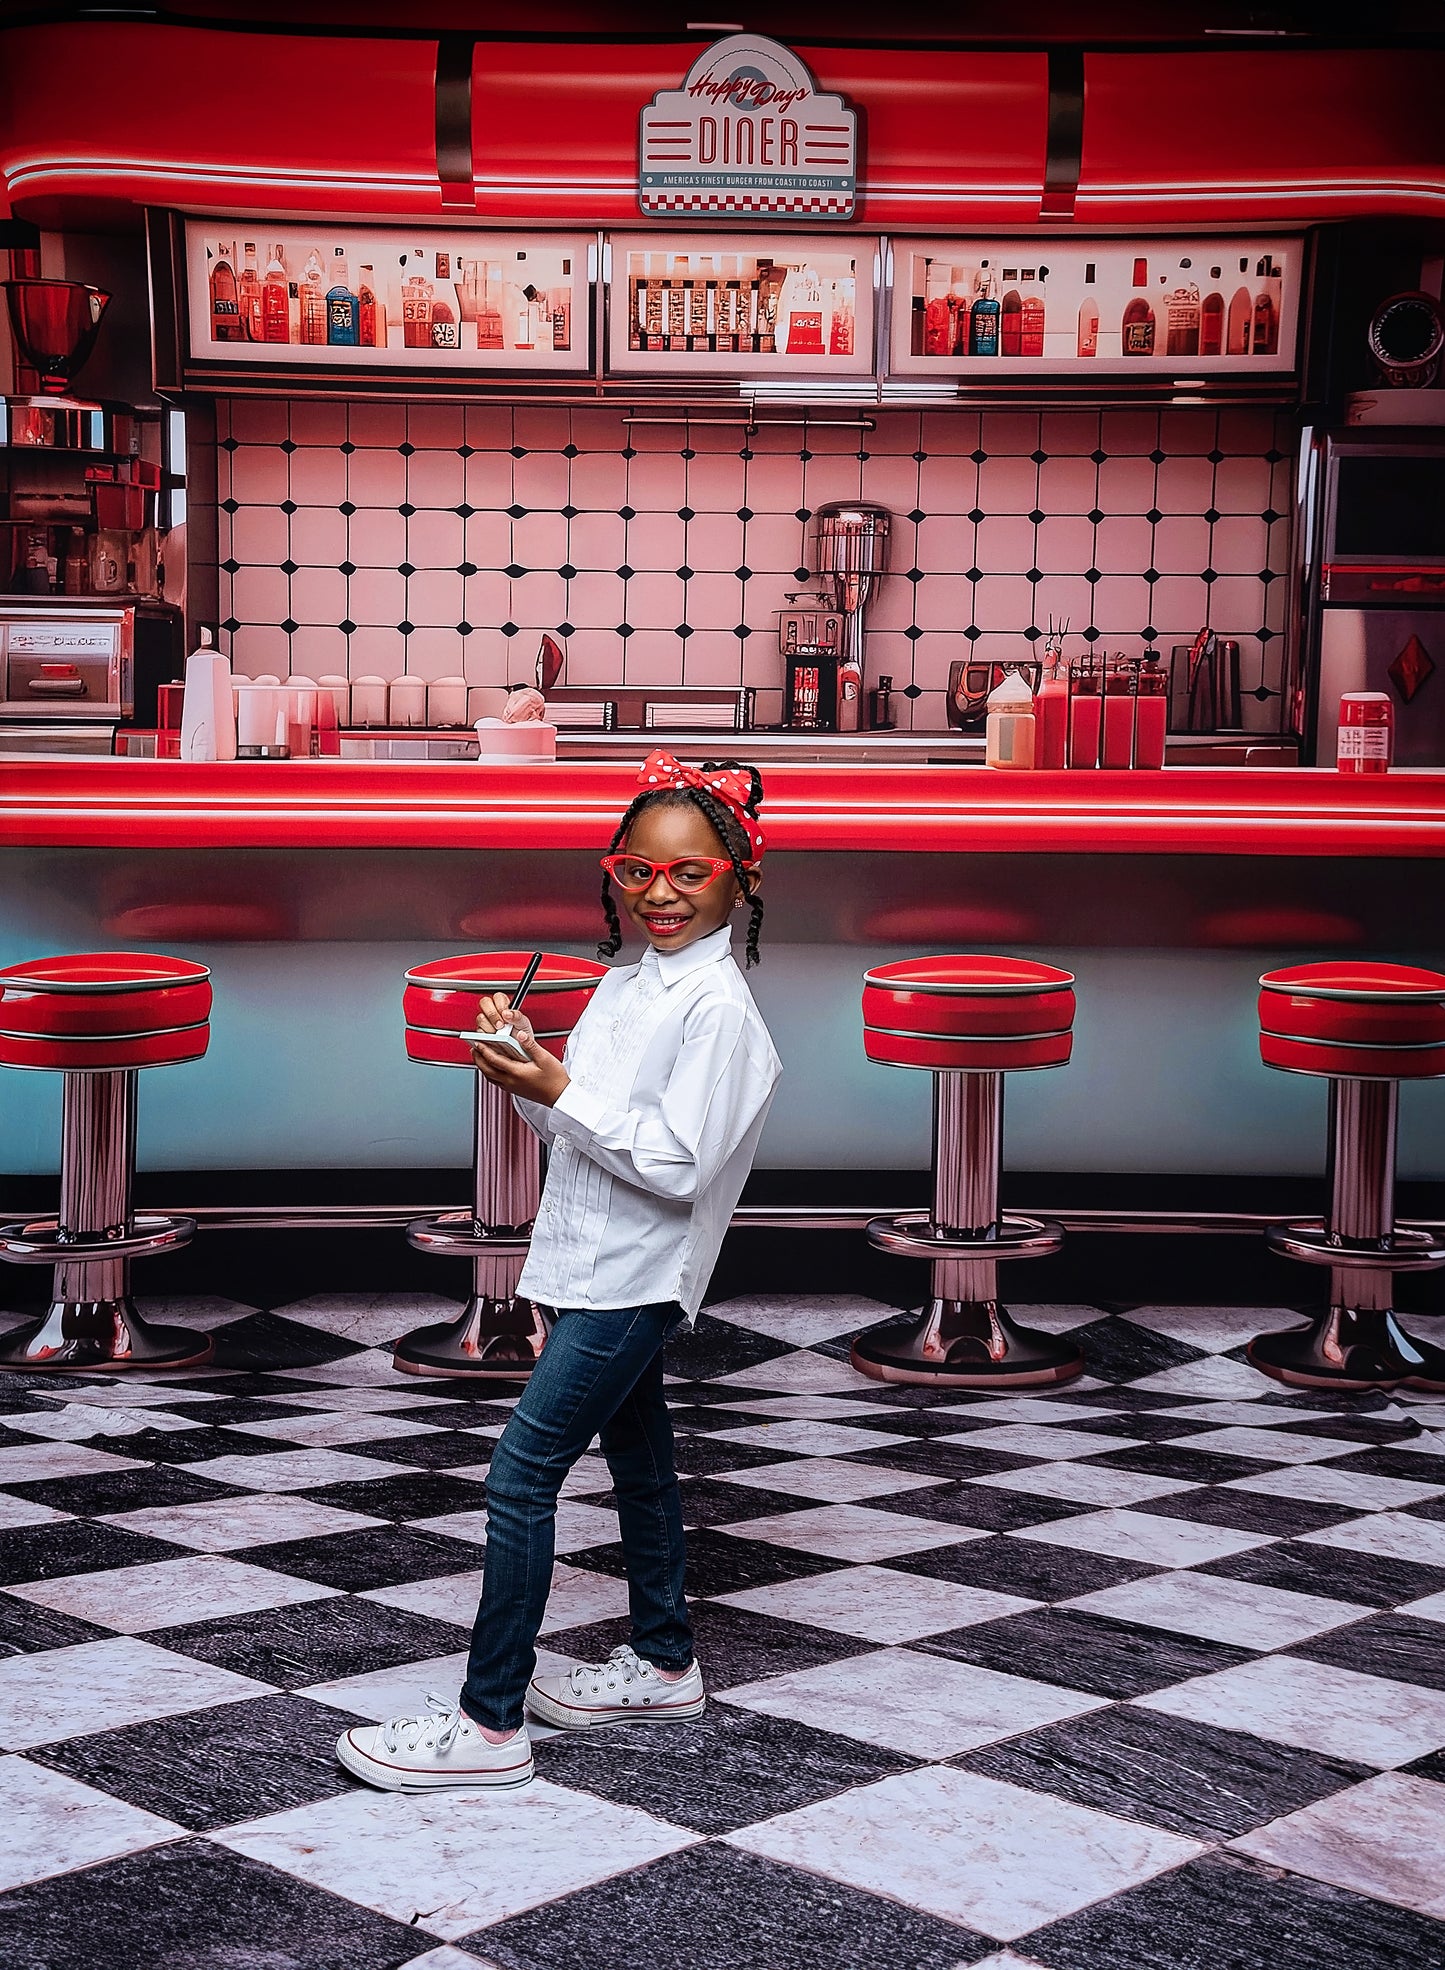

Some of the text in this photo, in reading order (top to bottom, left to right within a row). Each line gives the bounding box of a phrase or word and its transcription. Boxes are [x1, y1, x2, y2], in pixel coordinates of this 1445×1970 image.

[688, 72, 811, 114] Happy Days
[699, 116, 799, 166] DINER
[701, 176, 725, 185] FINEST
[726, 176, 753, 186] BURGER
[754, 177, 773, 186] FROM
[774, 177, 796, 186] COAST
[798, 178, 807, 187] TO
[808, 179, 833, 188] COAST!
